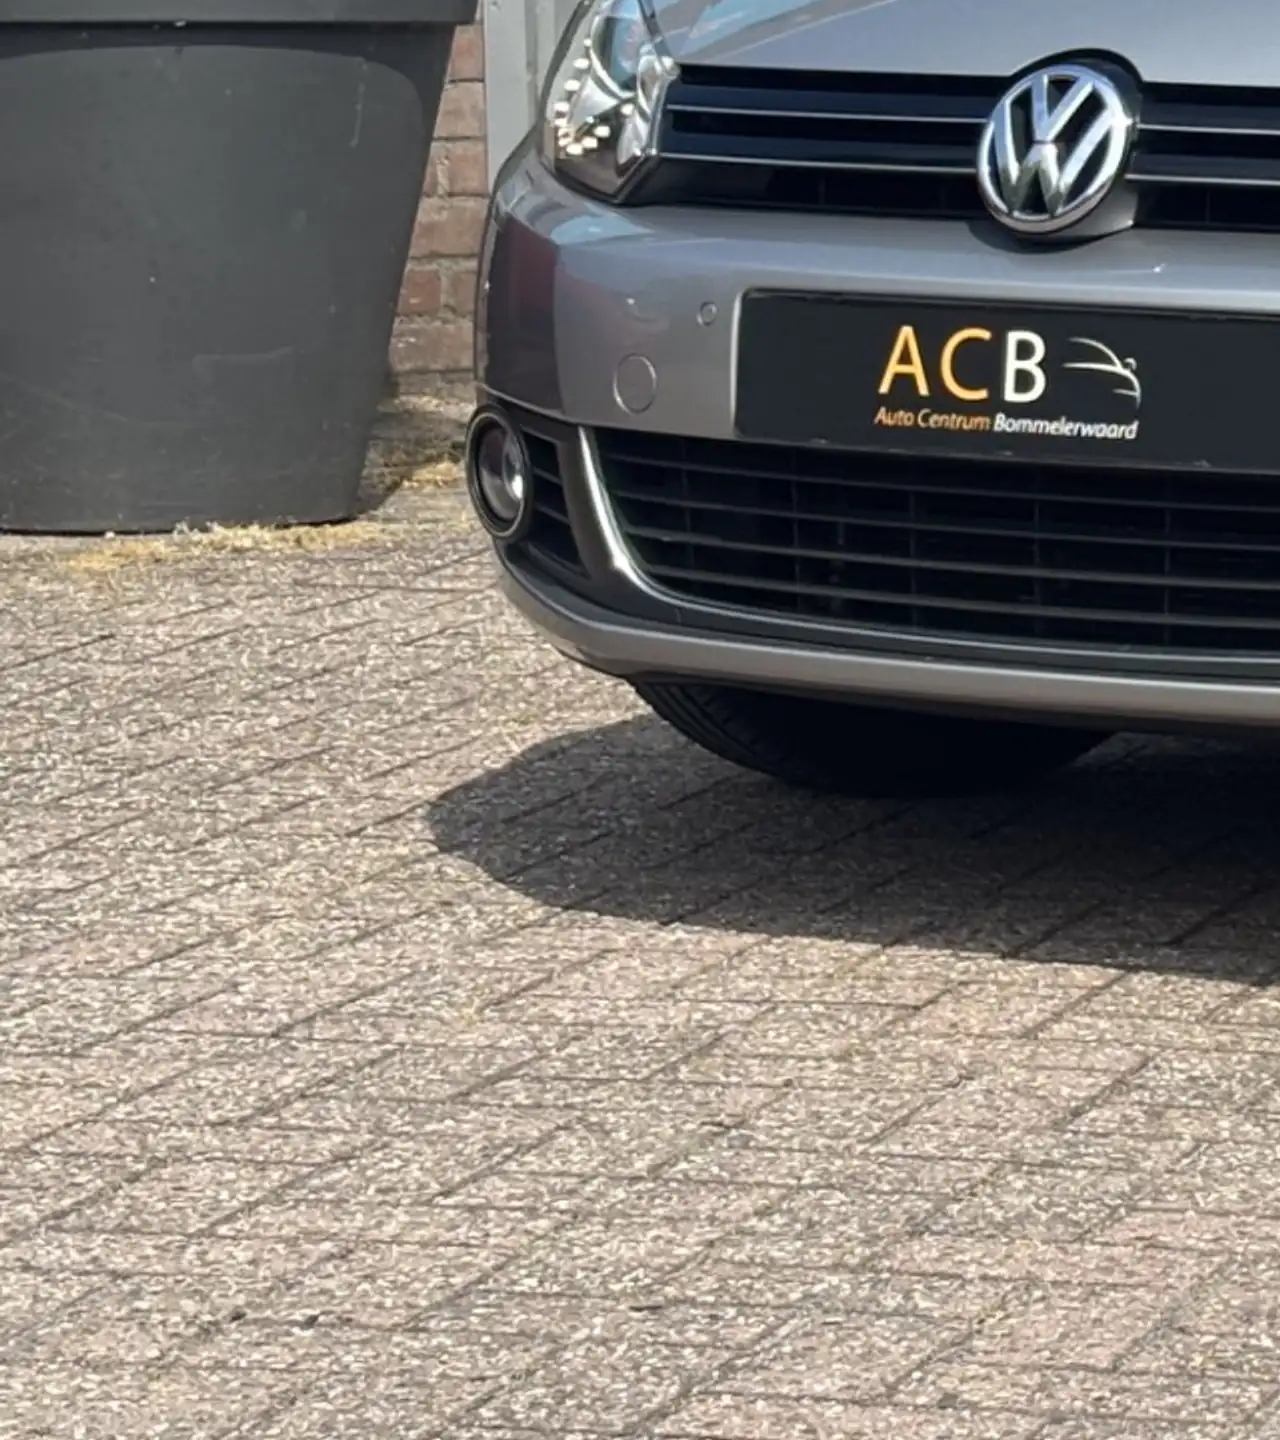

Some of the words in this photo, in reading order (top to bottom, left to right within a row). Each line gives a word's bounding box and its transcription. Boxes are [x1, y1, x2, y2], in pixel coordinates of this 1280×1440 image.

[877, 325, 1047, 403] ACB
[874, 406, 914, 427] Auto
[917, 409, 991, 431] Centrum
[993, 412, 1140, 440] Bommelerwaard
